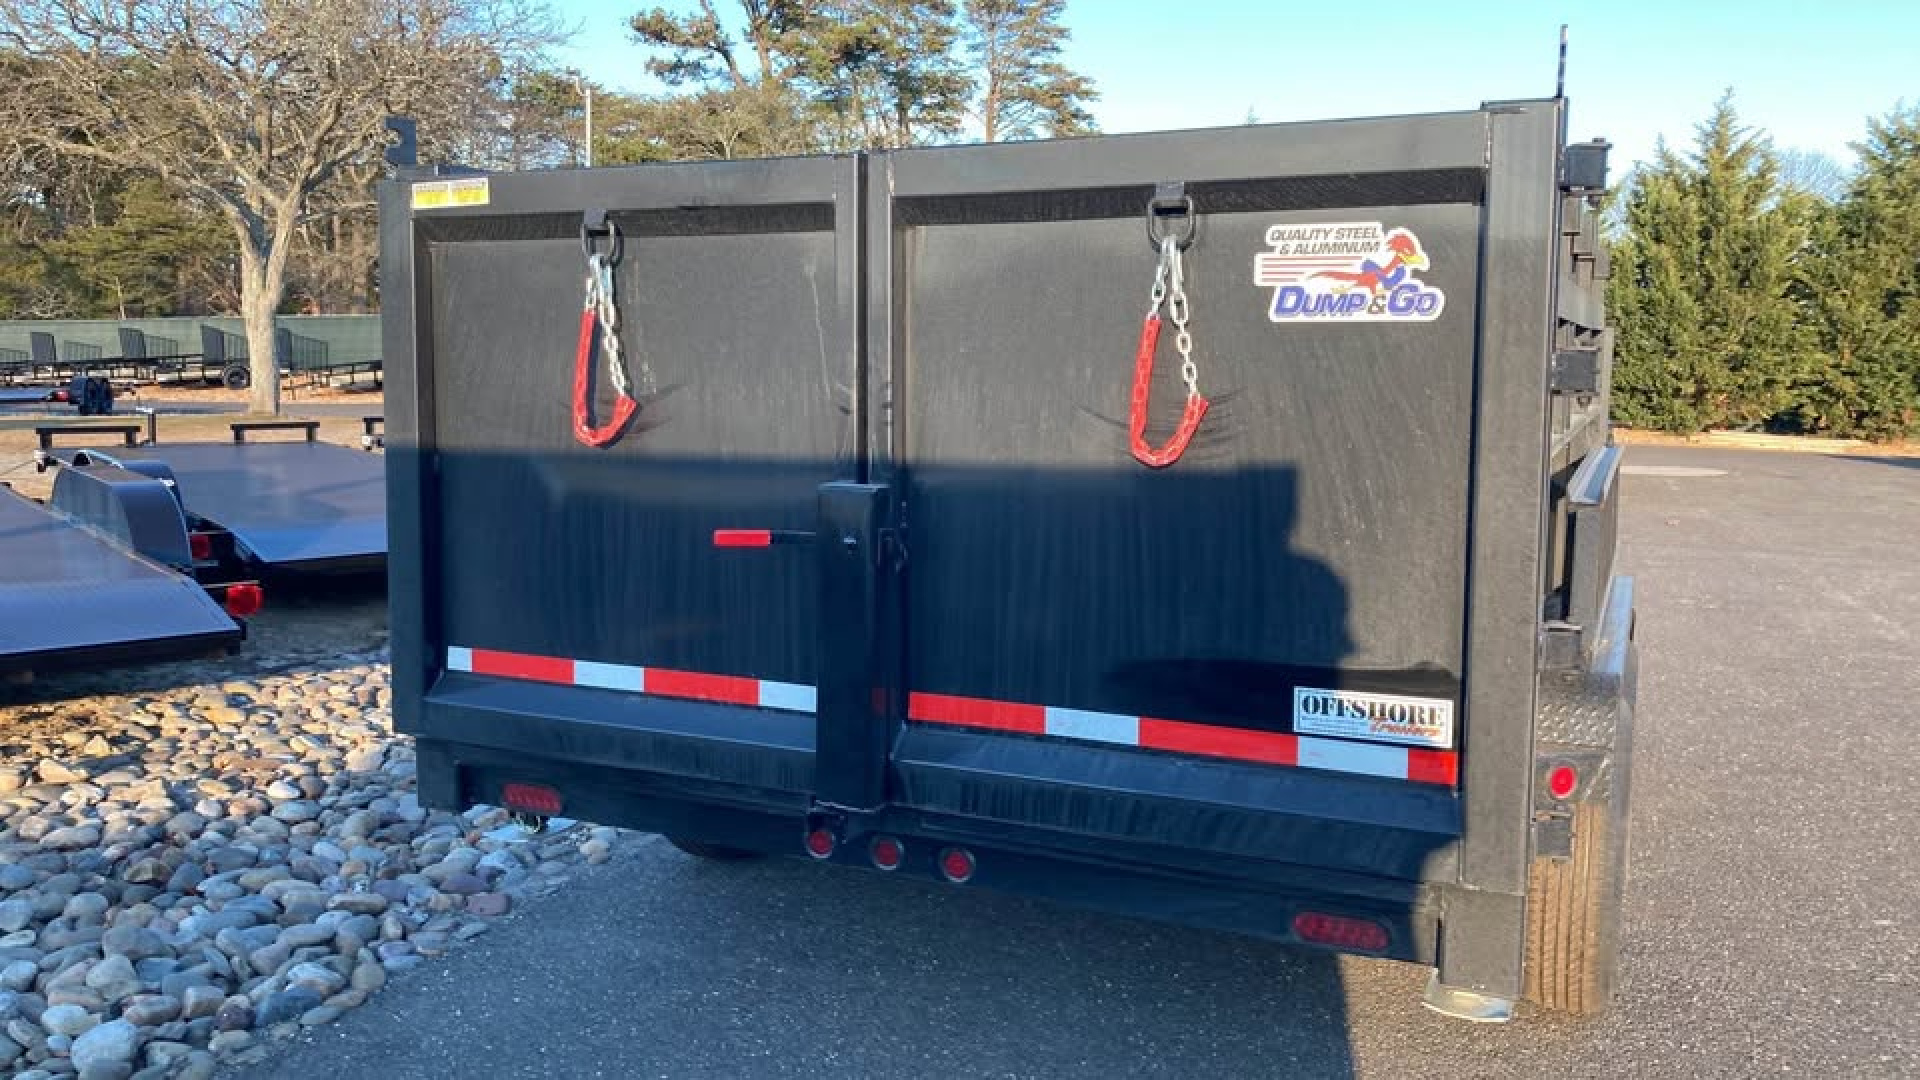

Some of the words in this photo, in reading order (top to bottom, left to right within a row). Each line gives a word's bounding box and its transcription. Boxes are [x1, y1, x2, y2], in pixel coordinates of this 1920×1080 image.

[1270, 227, 1333, 241] QUALITY
[1334, 226, 1380, 240] STEEL
[1279, 243, 1289, 255] &
[1293, 241, 1381, 255] ALUMINUM
[1302, 695, 1445, 727] OFFSHORE
